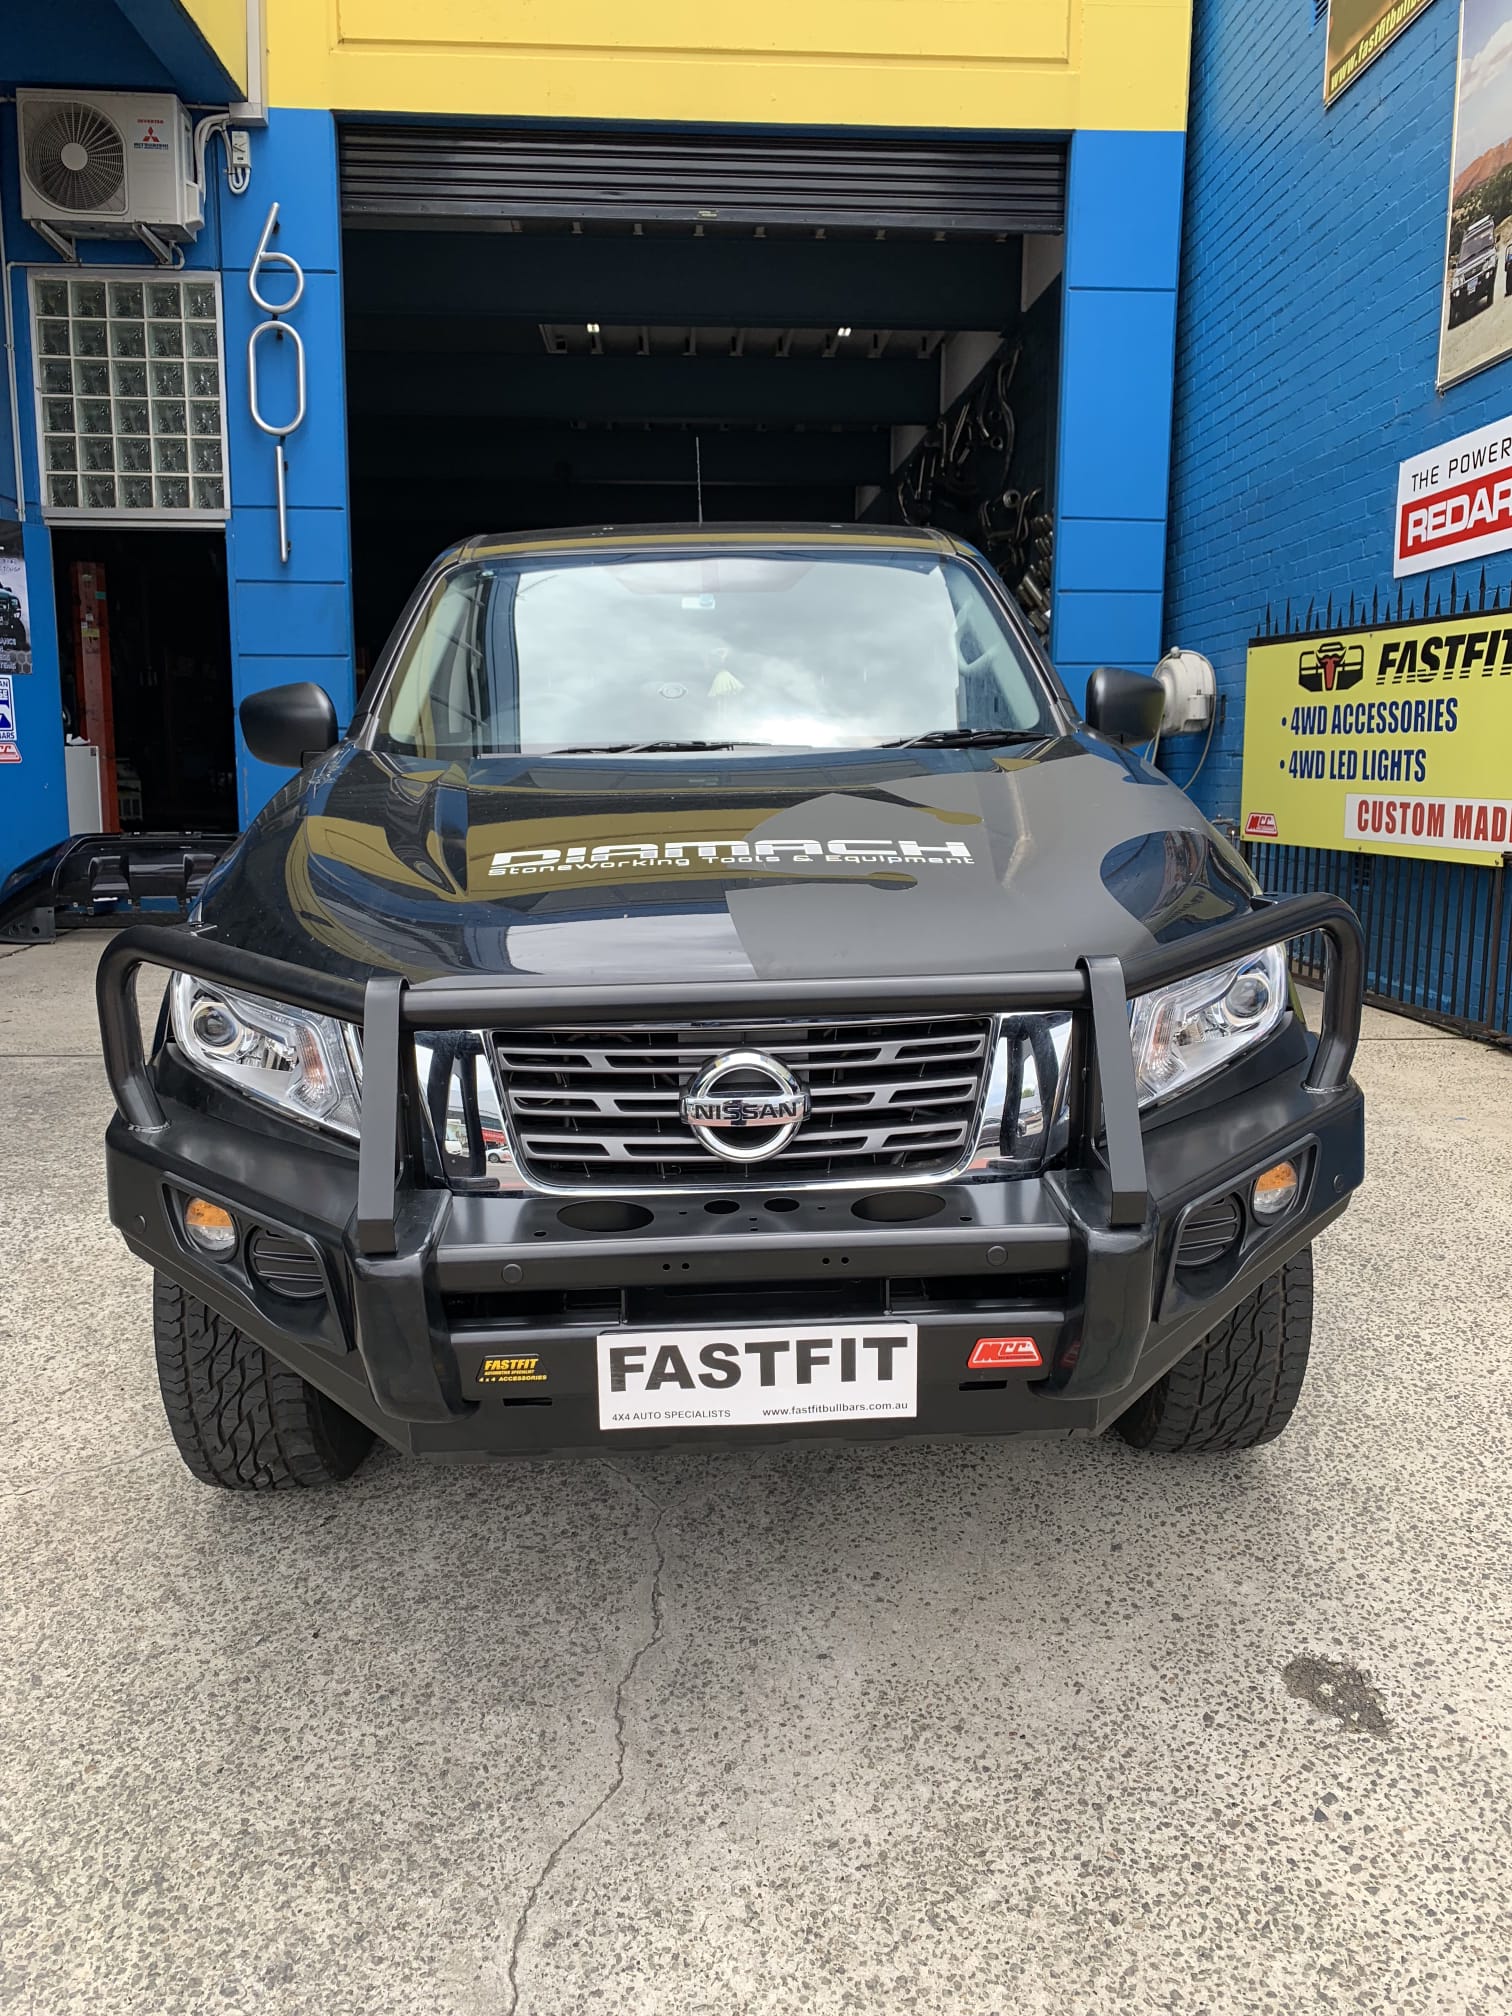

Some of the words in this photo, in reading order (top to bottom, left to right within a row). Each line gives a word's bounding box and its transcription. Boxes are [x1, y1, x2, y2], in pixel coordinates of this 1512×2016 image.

[1411, 465, 1440, 492] THE
[1448, 436, 1512, 479] POWER
[1290, 705, 1328, 735] 4WD
[1331, 697, 1458, 734] ACCESSORIES
[1288, 750, 1326, 779] 4WD
[1329, 750, 1358, 780] LED
[1362, 749, 1427, 782] LIGHTS
[1357, 799, 1446, 838] CUSTOM
[1453, 804, 1512, 843] MAD
[488, 857, 690, 876] Stoneworking
[702, 855, 780, 864] Tools
[793, 855, 814, 863] &
[825, 854, 976, 865] Equipment
[694, 1102, 797, 1120] NISSAN
[484, 1358, 539, 1371] FASTFIT
[609, 1336, 908, 1392] FASTFIT
[498, 1374, 548, 1383] ACCESSORIES
[611, 1413, 630, 1421] 4X4
[632, 1411, 662, 1420] AUTO
[664, 1409, 731, 1419] SPECIALISTS
[762, 1401, 908, 1416] www.fastfitbullbars.com.au
